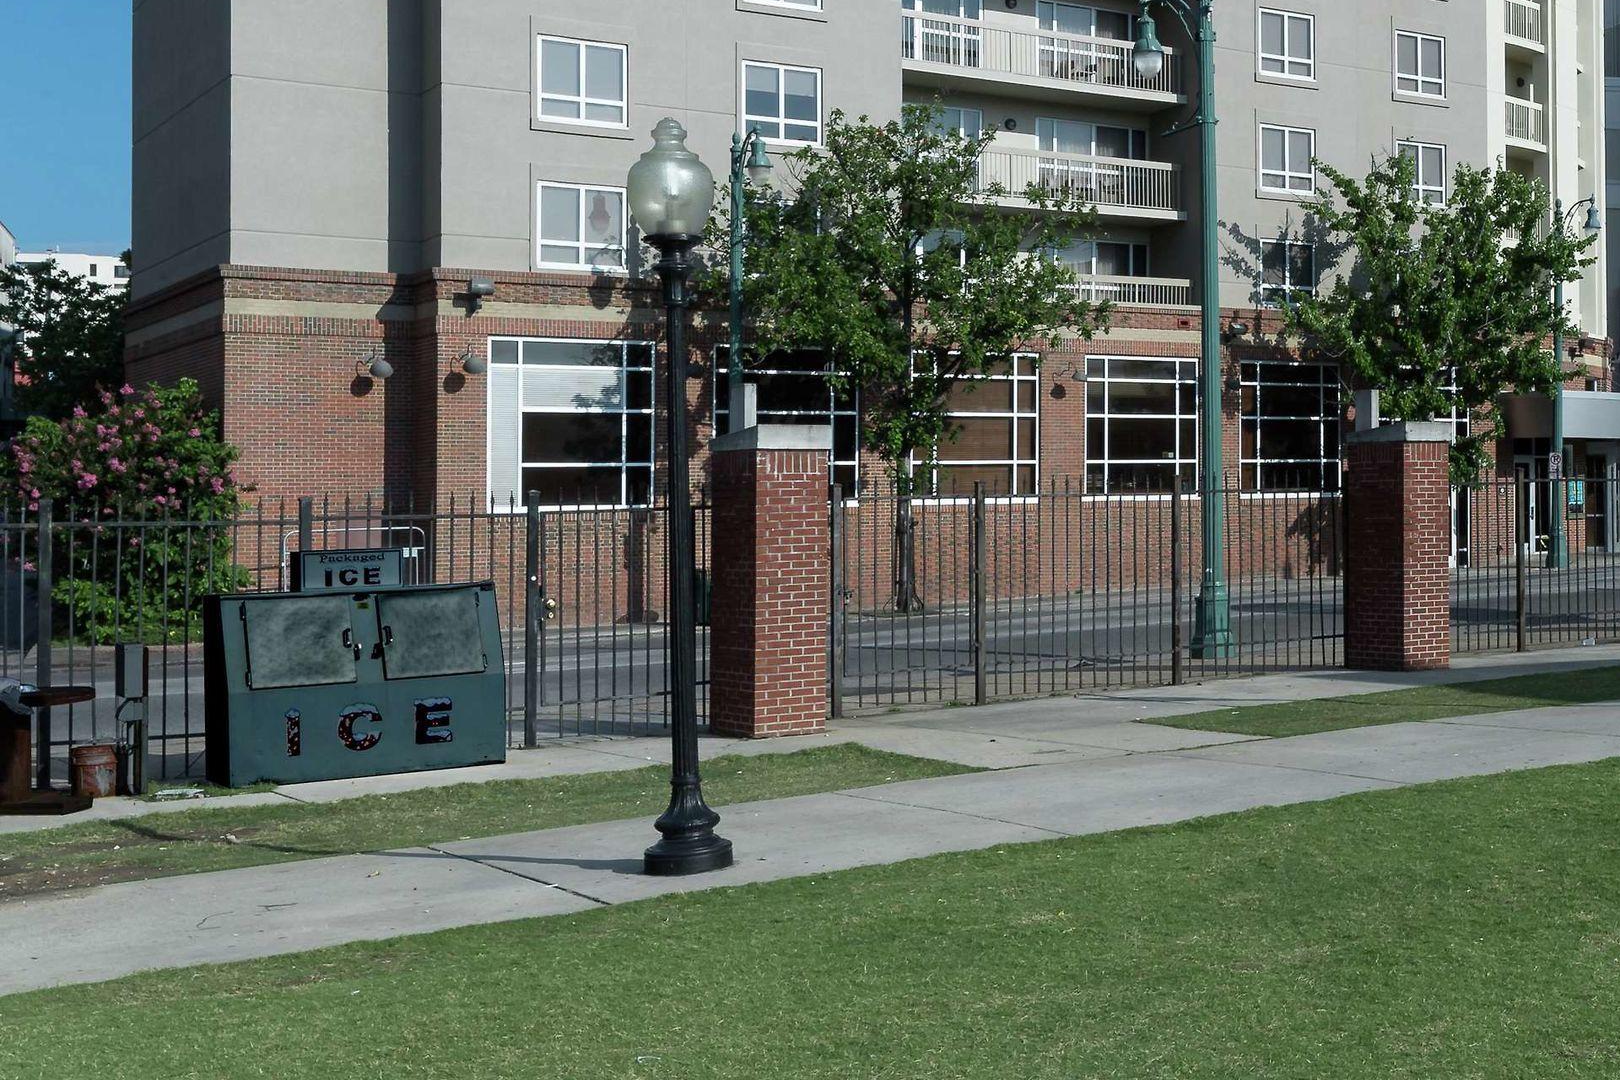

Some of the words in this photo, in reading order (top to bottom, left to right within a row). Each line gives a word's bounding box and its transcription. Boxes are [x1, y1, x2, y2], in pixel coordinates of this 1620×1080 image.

[320, 552, 385, 564] Packaged
[324, 567, 381, 587] ICE
[285, 696, 453, 756] ICE
